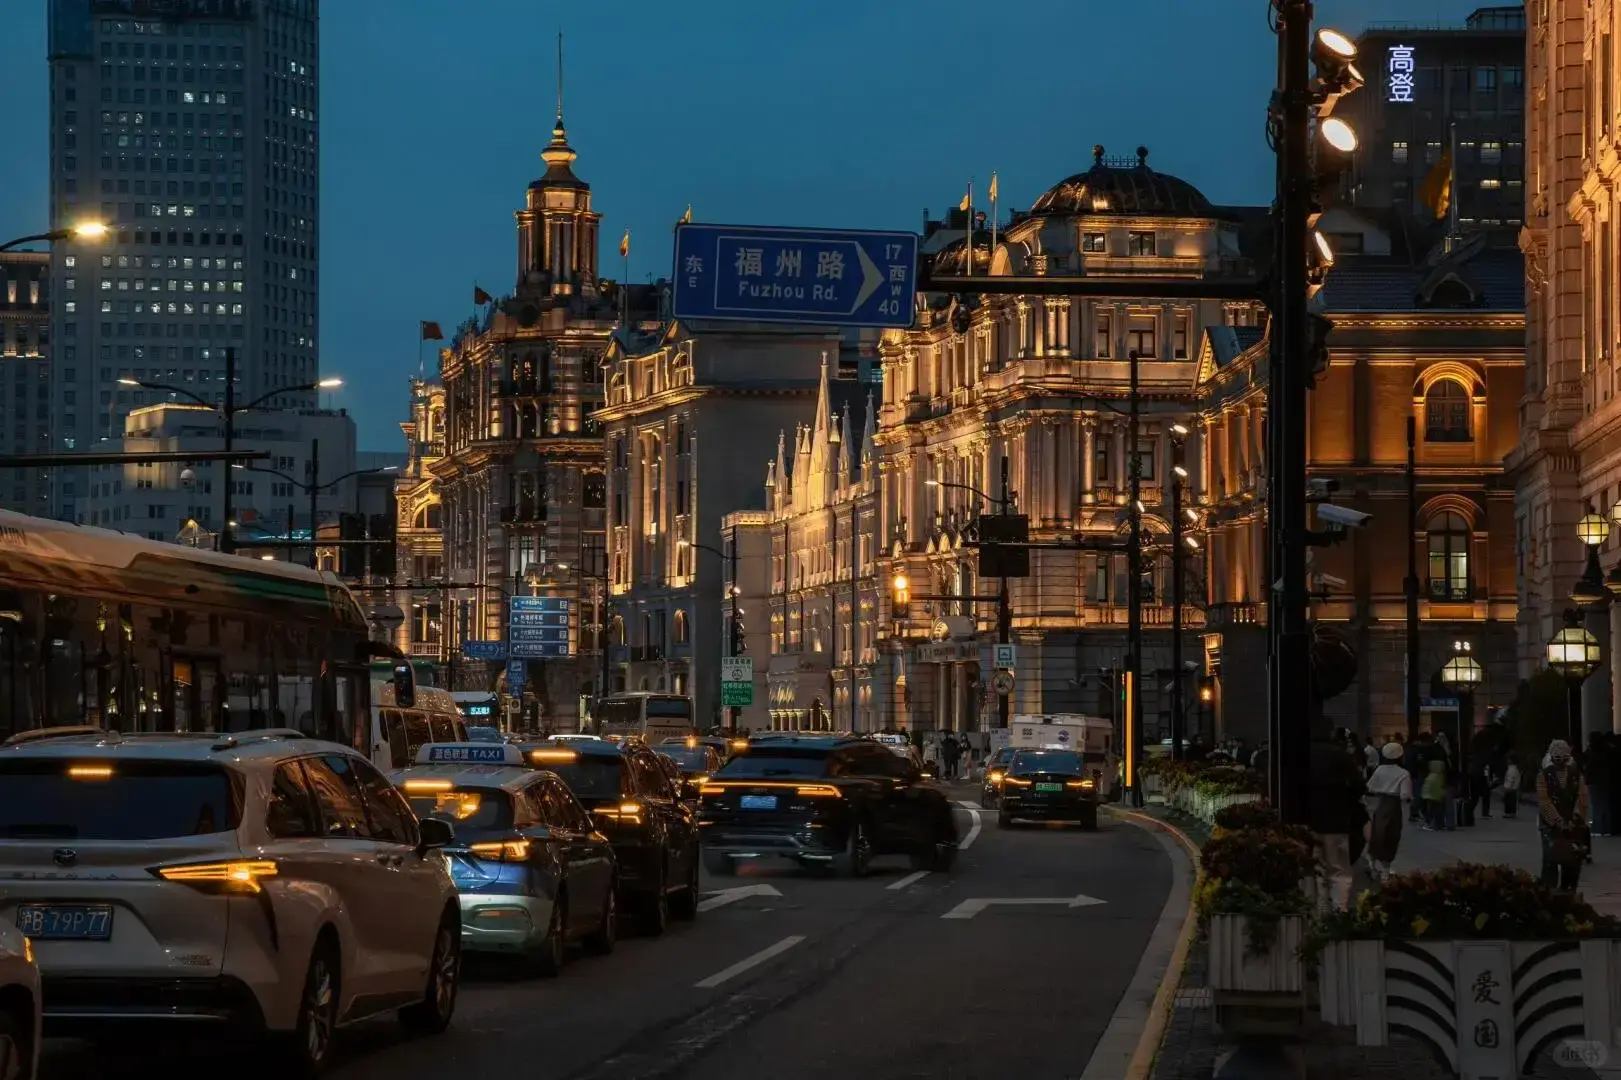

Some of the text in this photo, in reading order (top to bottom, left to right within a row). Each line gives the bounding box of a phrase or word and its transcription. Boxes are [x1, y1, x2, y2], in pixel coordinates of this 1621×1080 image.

[1389, 44, 1415, 102] 高登
[885, 243, 902, 260] 17
[685, 254, 703, 273] 东
[734, 247, 845, 280] 福州路
[688, 276, 697, 288] E
[889, 264, 908, 282] 西
[738, 281, 838, 301] Fuzhou Rd.
[890, 285, 902, 296] W
[878, 300, 900, 316] 40
[471, 749, 500, 760] TAXI
[1471, 970, 1501, 1049] 爱国
